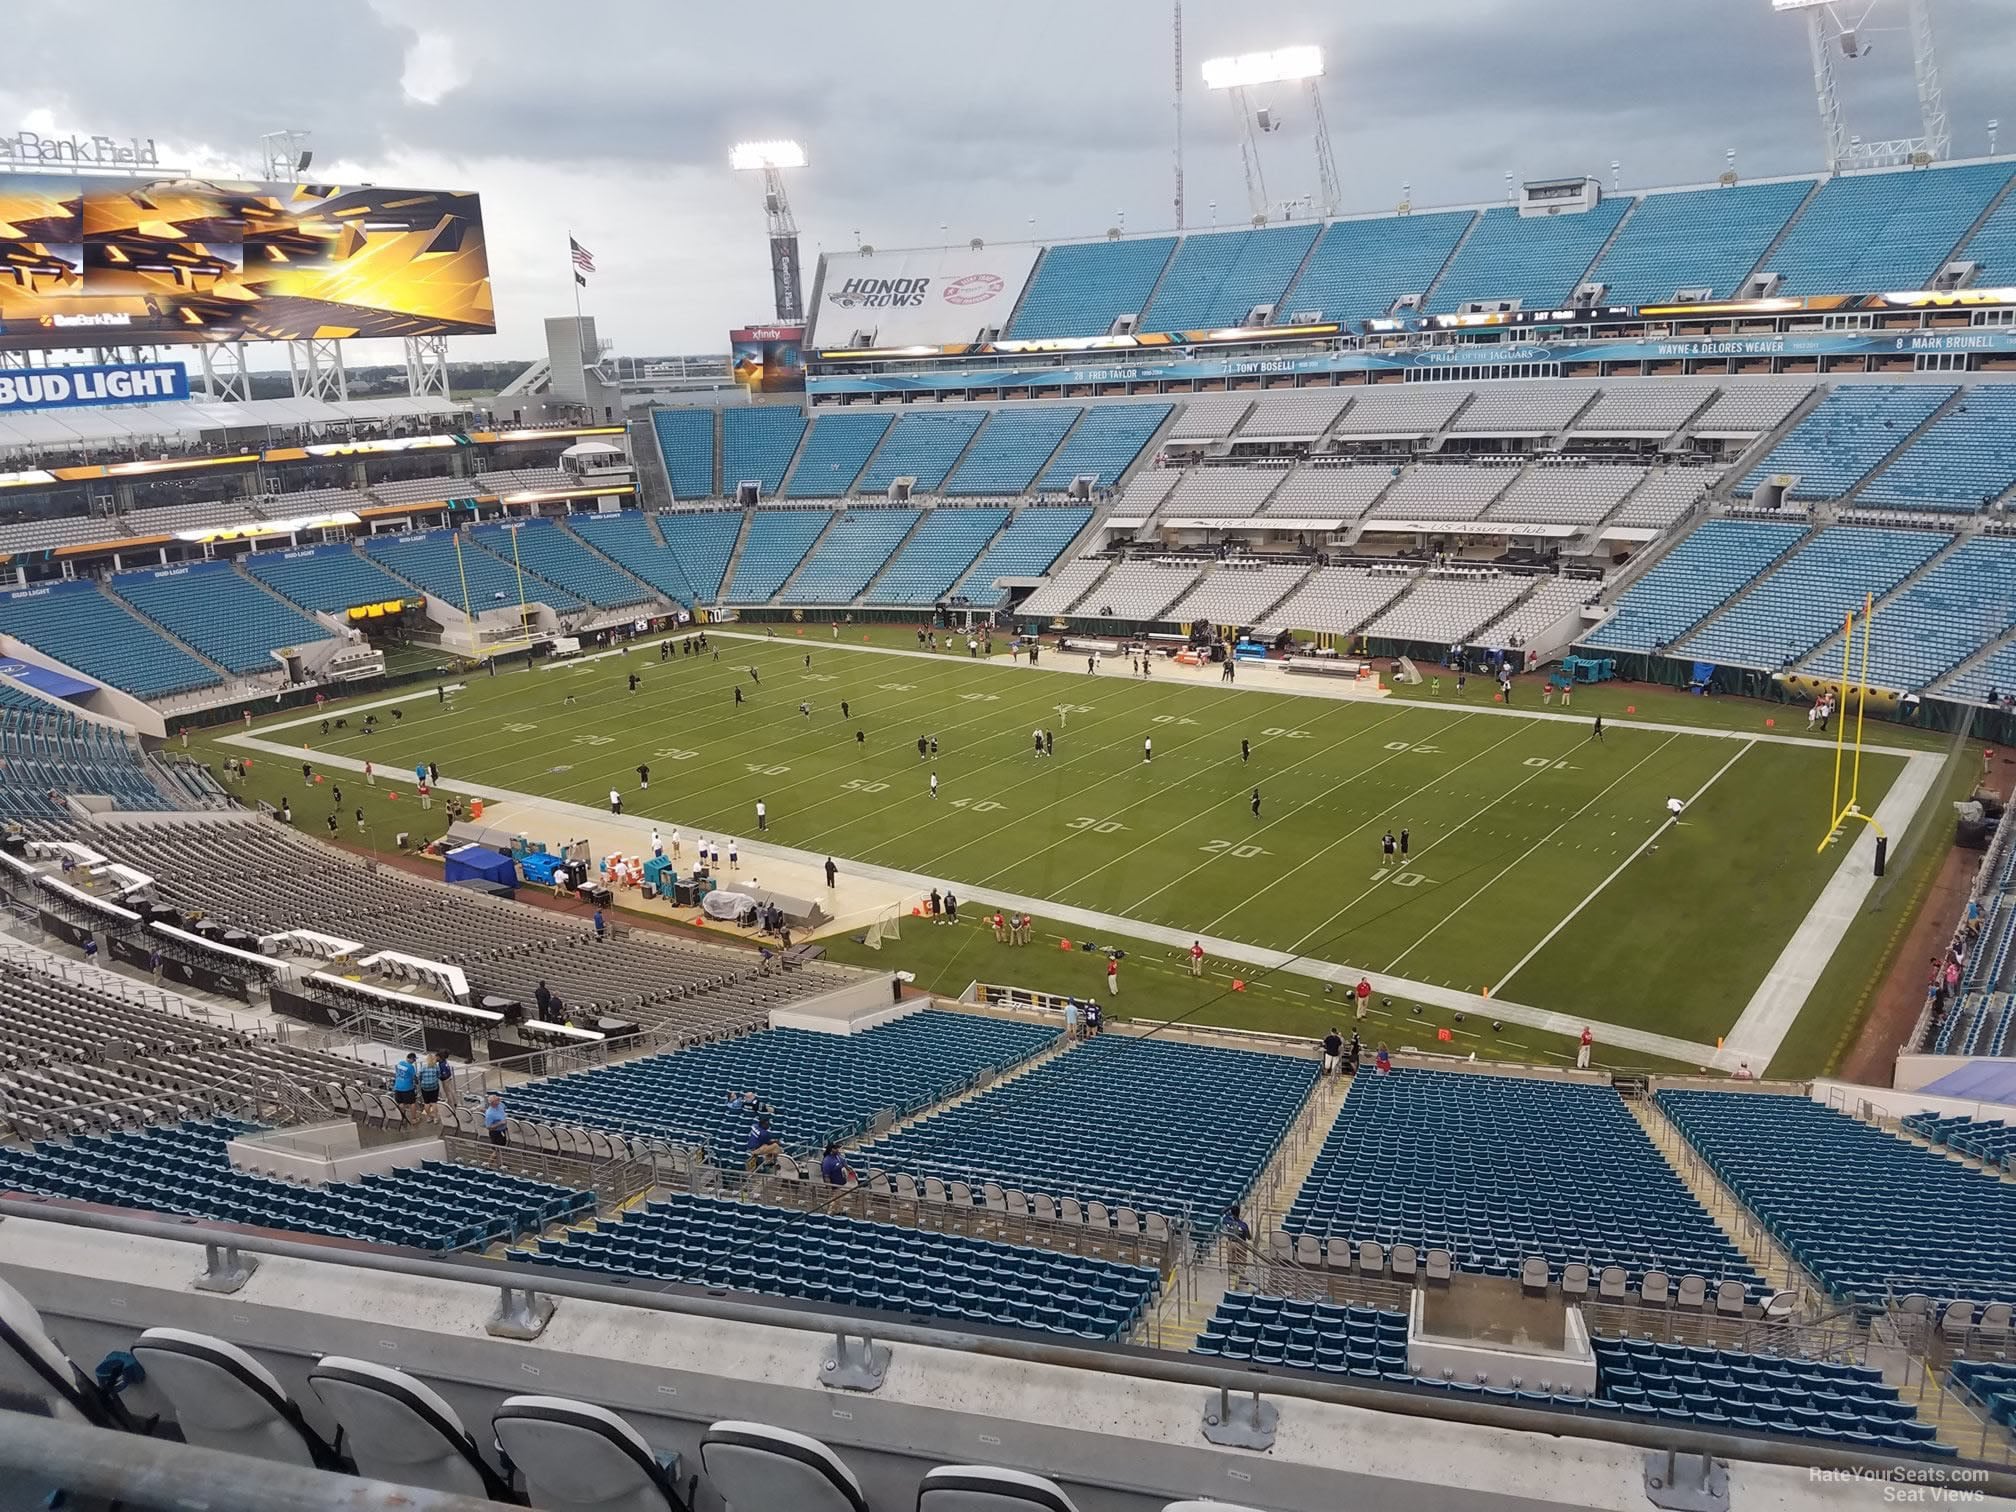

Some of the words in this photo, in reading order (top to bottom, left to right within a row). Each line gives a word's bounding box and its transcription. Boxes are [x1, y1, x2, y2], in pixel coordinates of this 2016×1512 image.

[92, 137, 159, 164] Field
[842, 278, 930, 294] HONOR
[863, 294, 925, 307] ROWS
[752, 330, 781, 340] xfinity
[1658, 344, 1689, 355] WAYNE
[1692, 343, 1699, 354] &
[1702, 342, 1743, 354] DELORES
[1745, 341, 1784, 353] WEAVER
[1896, 338, 1904, 349] 8
[1912, 337, 1943, 349] MARK
[1945, 335, 1994, 348] BRUNELL
[1430, 353, 1459, 363] PRIDE
[1489, 350, 1534, 360] JAGUARS
[1236, 362, 1258, 373] TONY
[1260, 360, 1295, 372] BOSELLI
[1089, 371, 1107, 380] FRED
[1109, 370, 1137, 379] TAYLOR
[0, 375, 70, 404] BUD
[73, 369, 176, 400] LIGHT
[1430, 523, 1453, 531] US
[1454, 523, 1508, 533] Assure
[1511, 525, 1546, 534] Club
[169, 567, 189, 577] LIGHT
[28, 587, 50, 597] LIGHT
[1383, 741, 1438, 753] 20
[1522, 757, 1568, 770] 10
[840, 779, 891, 793] 50
[950, 798, 1001, 812] 40
[1066, 817, 1123, 833] 30
[1198, 840, 1263, 858] 20
[1369, 868, 1426, 887] 10
